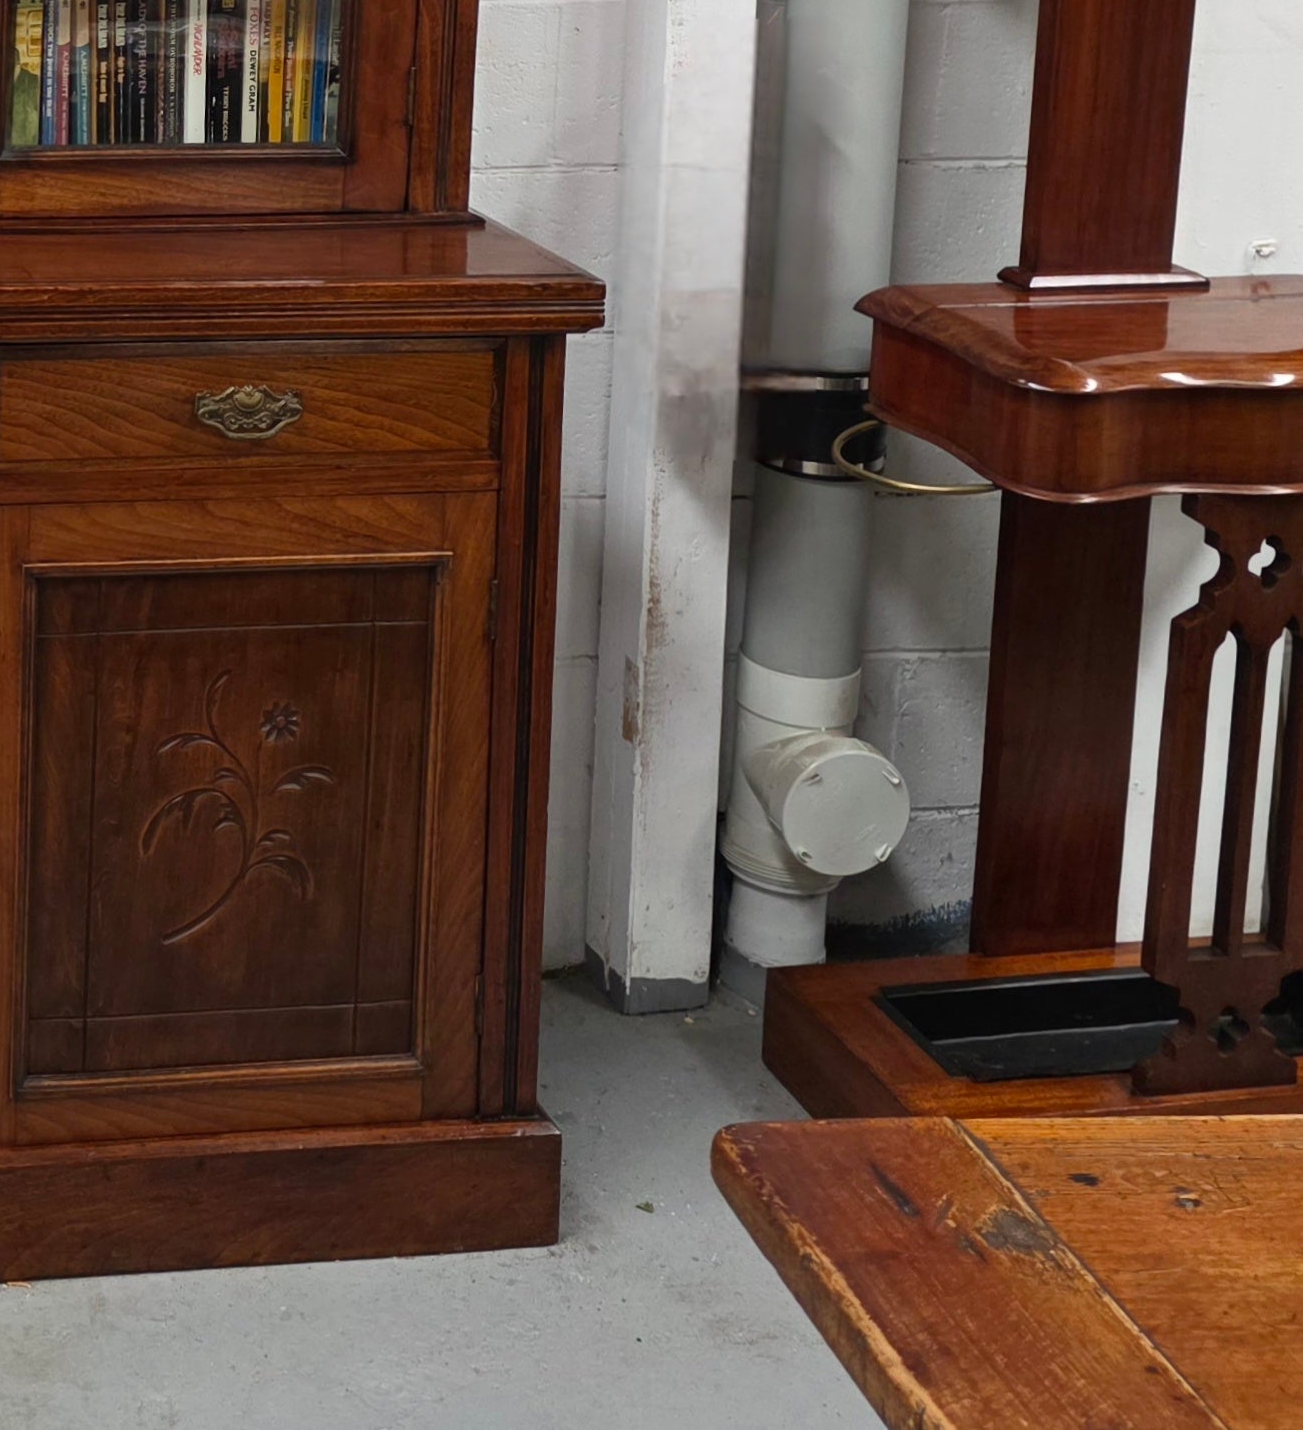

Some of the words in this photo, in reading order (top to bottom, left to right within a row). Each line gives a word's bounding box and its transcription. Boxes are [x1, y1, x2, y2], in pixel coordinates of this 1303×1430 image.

[138, 23, 146, 37] OF
[249, 6, 258, 46] FOXES
[138, 39, 146, 58] THE
[192, 23, 204, 76] HIGHLANDER
[138, 59, 147, 95] HAVEN
[249, 50, 257, 83] DEWEY
[248, 85, 257, 112] GRAM
